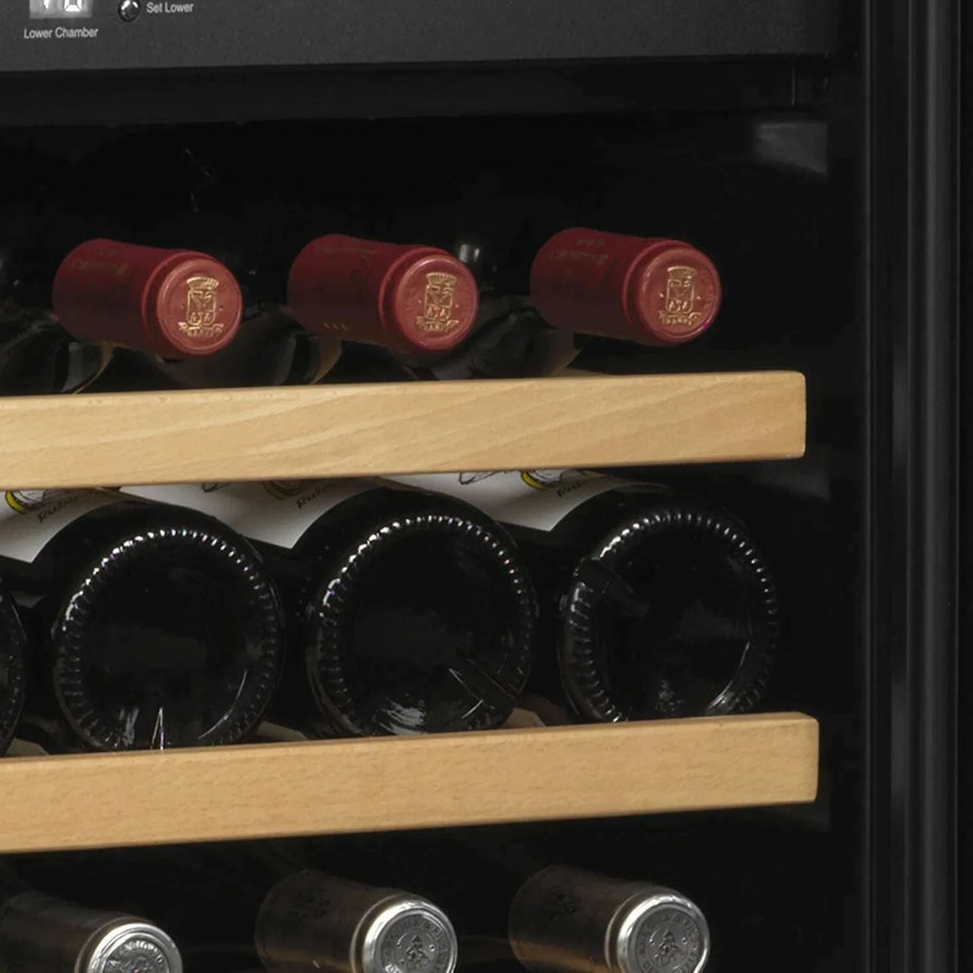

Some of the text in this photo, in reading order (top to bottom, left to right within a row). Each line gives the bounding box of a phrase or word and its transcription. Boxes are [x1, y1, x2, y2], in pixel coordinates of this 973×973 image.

[147, 1, 194, 14] Set Lower
[23, 27, 99, 40] Lower Chamber
